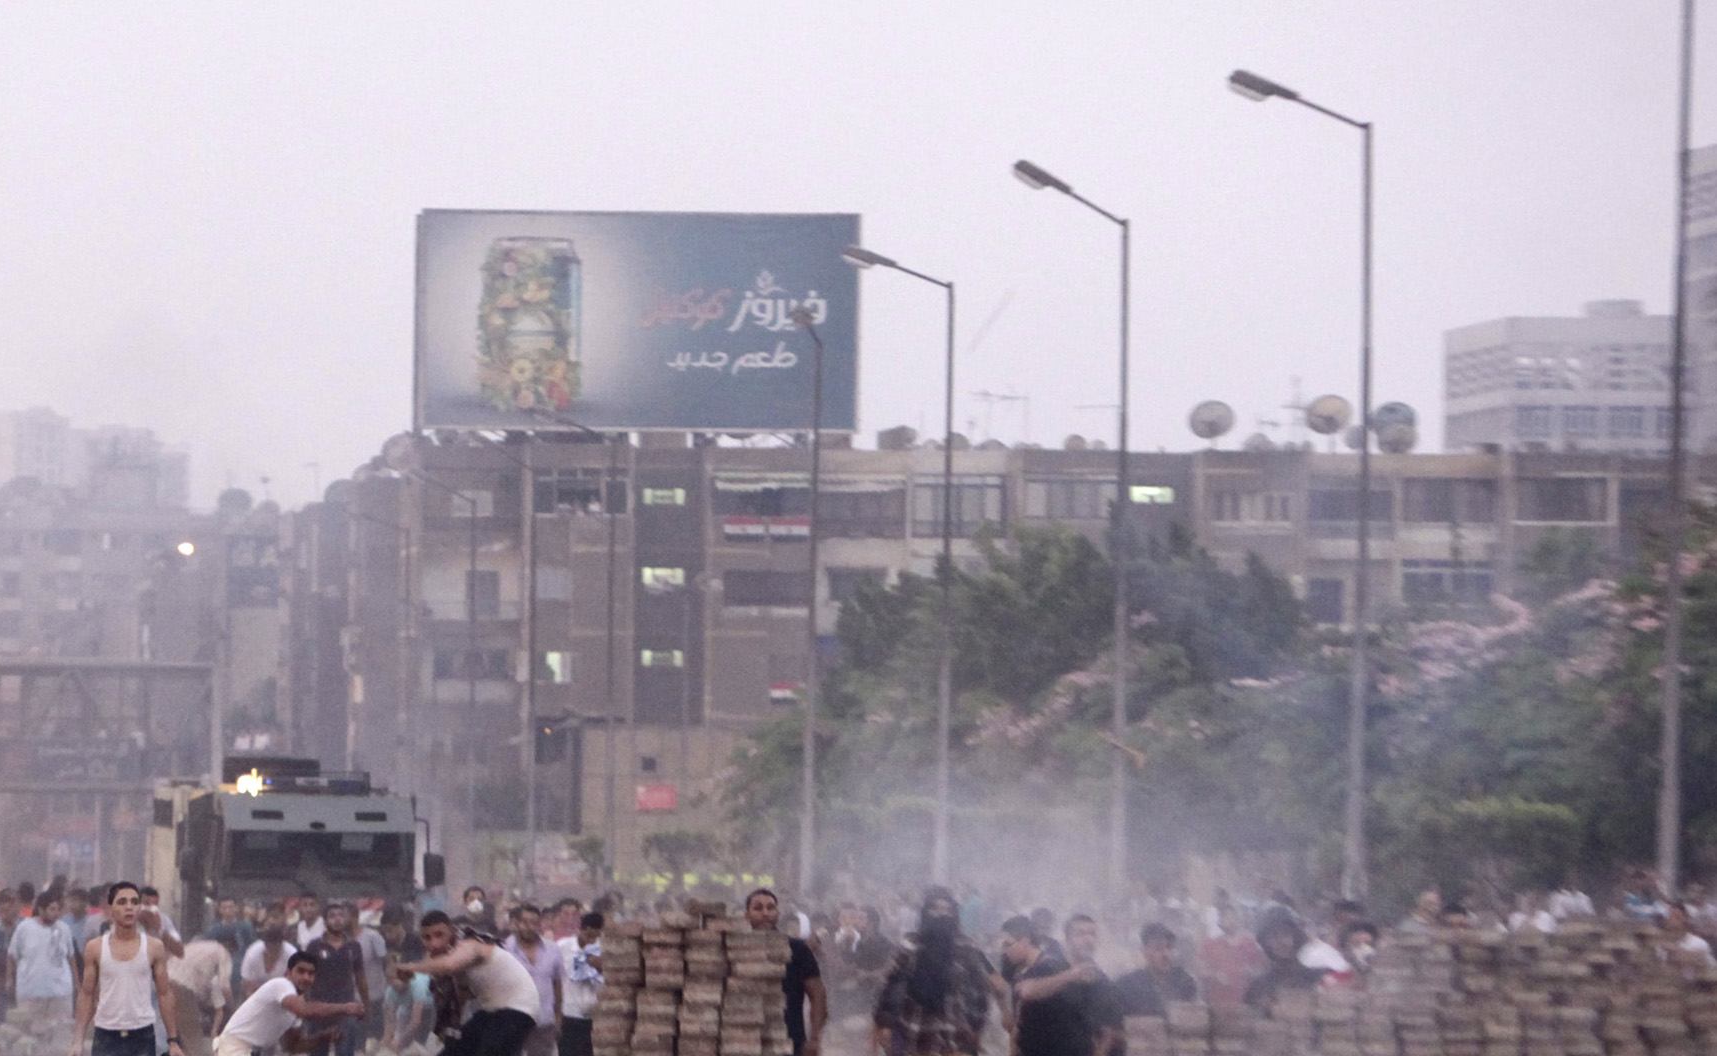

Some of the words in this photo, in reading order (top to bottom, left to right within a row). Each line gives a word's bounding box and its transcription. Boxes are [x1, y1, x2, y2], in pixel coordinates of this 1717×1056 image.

[726, 290, 828, 332] فيروز
[666, 351, 729, 372] جديد
[731, 340, 798, 375] طعم
